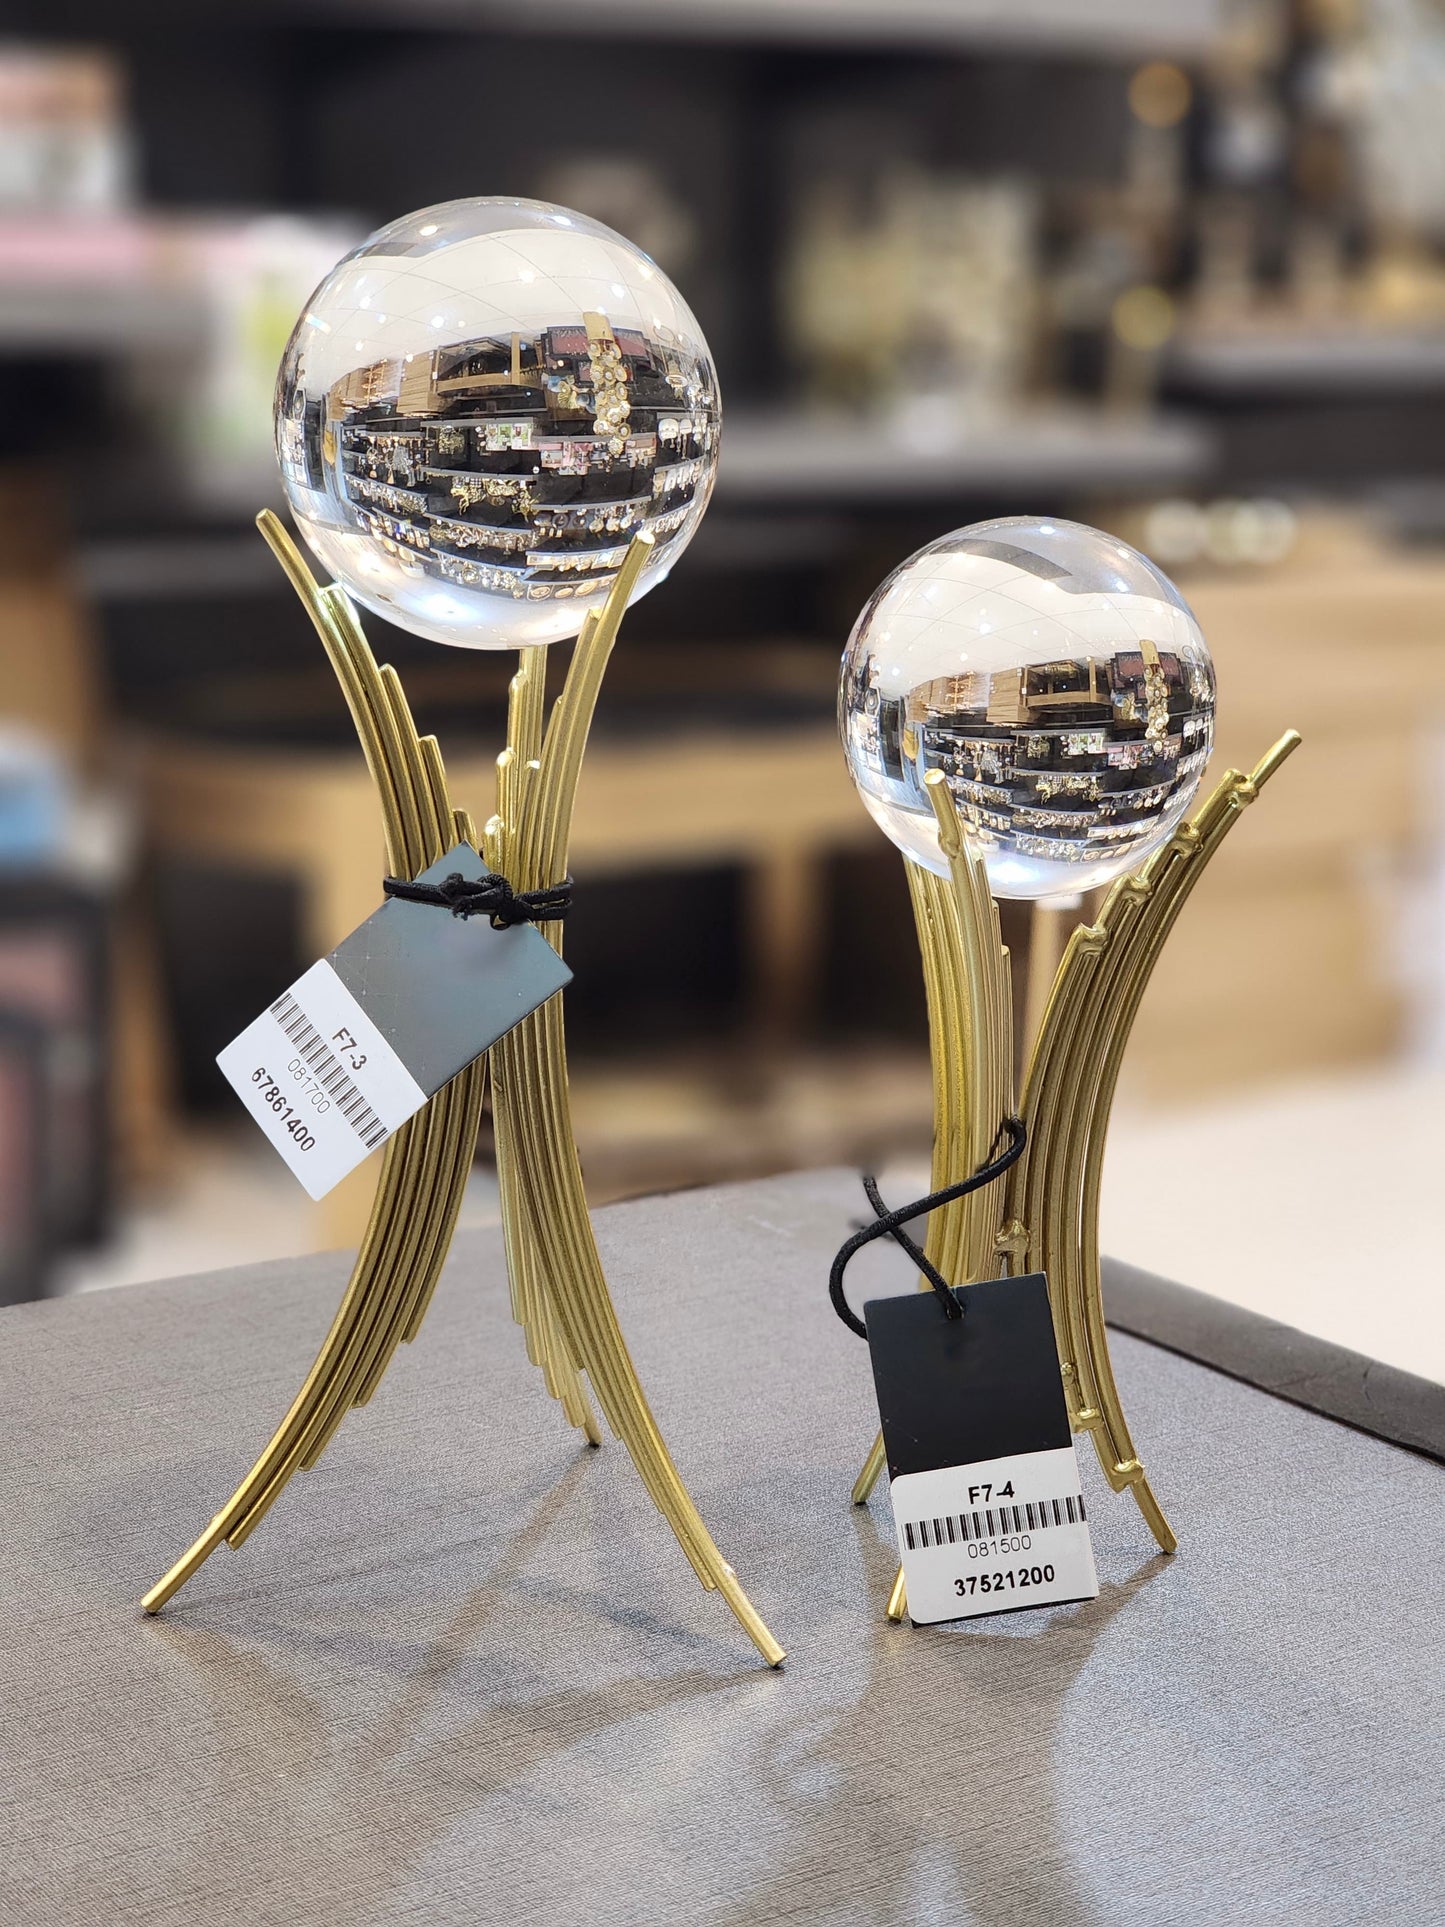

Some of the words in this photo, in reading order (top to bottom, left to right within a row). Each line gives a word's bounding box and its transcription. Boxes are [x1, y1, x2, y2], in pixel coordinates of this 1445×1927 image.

[332, 1027, 367, 1070] F7-3
[287, 1058, 331, 1114] 081700
[251, 1067, 316, 1152] 67861400
[968, 1481, 1015, 1504] F7-4
[968, 1535, 1032, 1559] 081500
[954, 1564, 1055, 1597] 37521200
